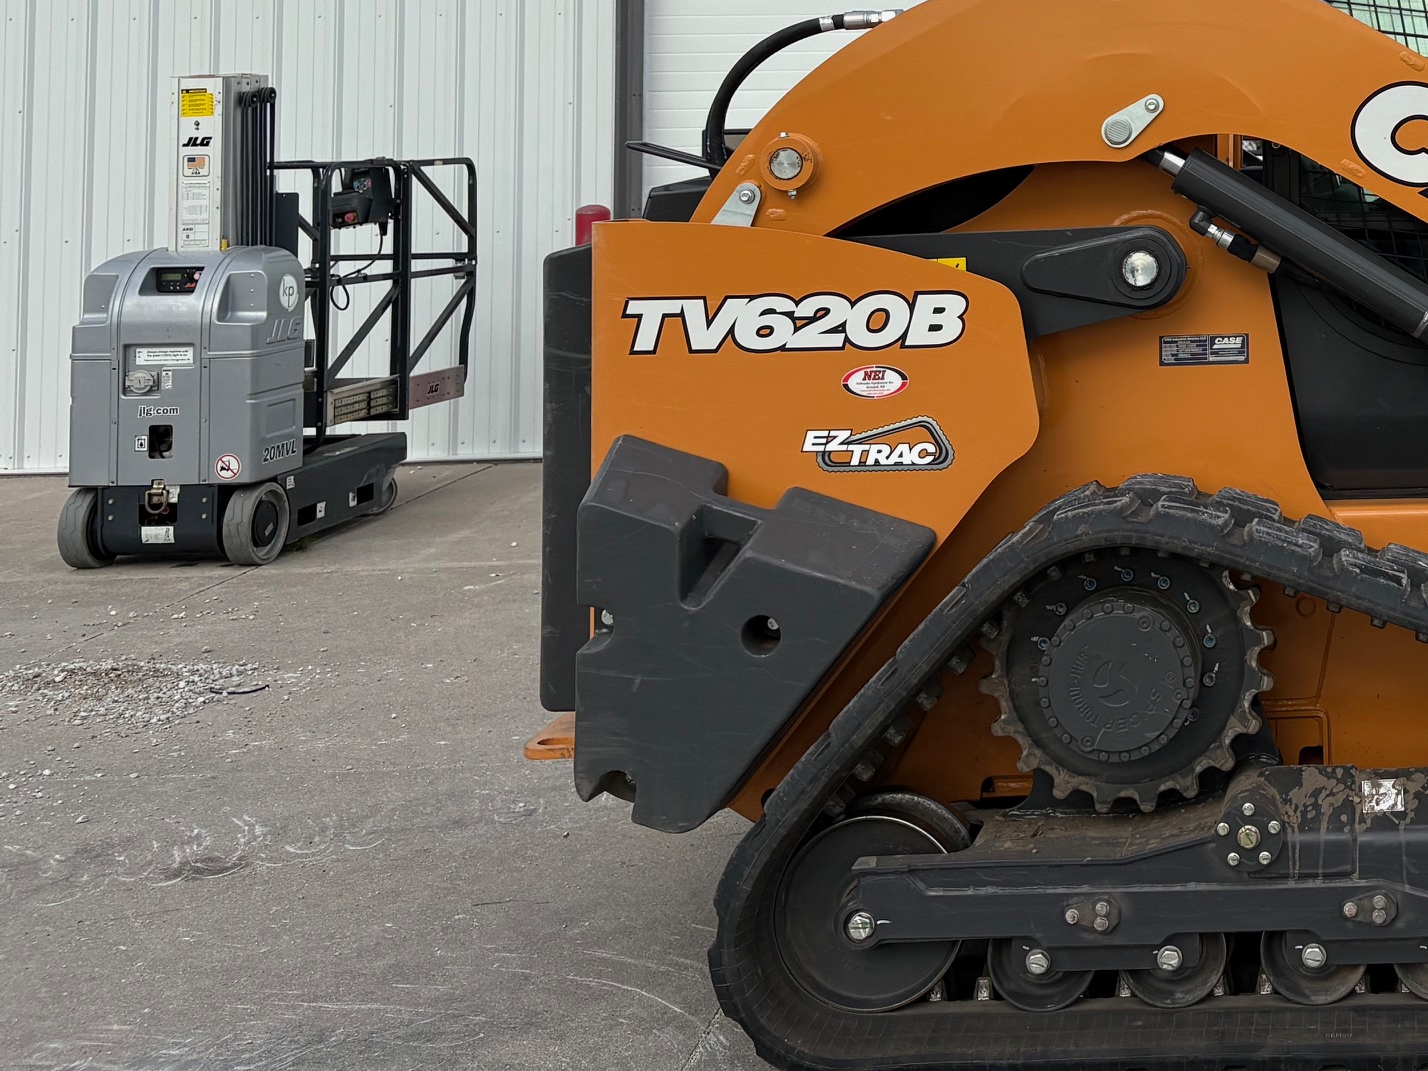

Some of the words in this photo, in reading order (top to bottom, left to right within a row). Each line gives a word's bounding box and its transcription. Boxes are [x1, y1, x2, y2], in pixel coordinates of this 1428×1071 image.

[182, 137, 213, 147] JLG
[282, 277, 295, 308] kp
[266, 316, 304, 345] JLG
[621, 290, 969, 355] TV620B
[862, 370, 886, 381] NEI
[427, 383, 440, 395] JLG
[137, 406, 179, 418] jlg.com
[262, 439, 297, 464] 20MVL
[801, 429, 853, 452] EZ
[846, 442, 937, 466] TRAC
